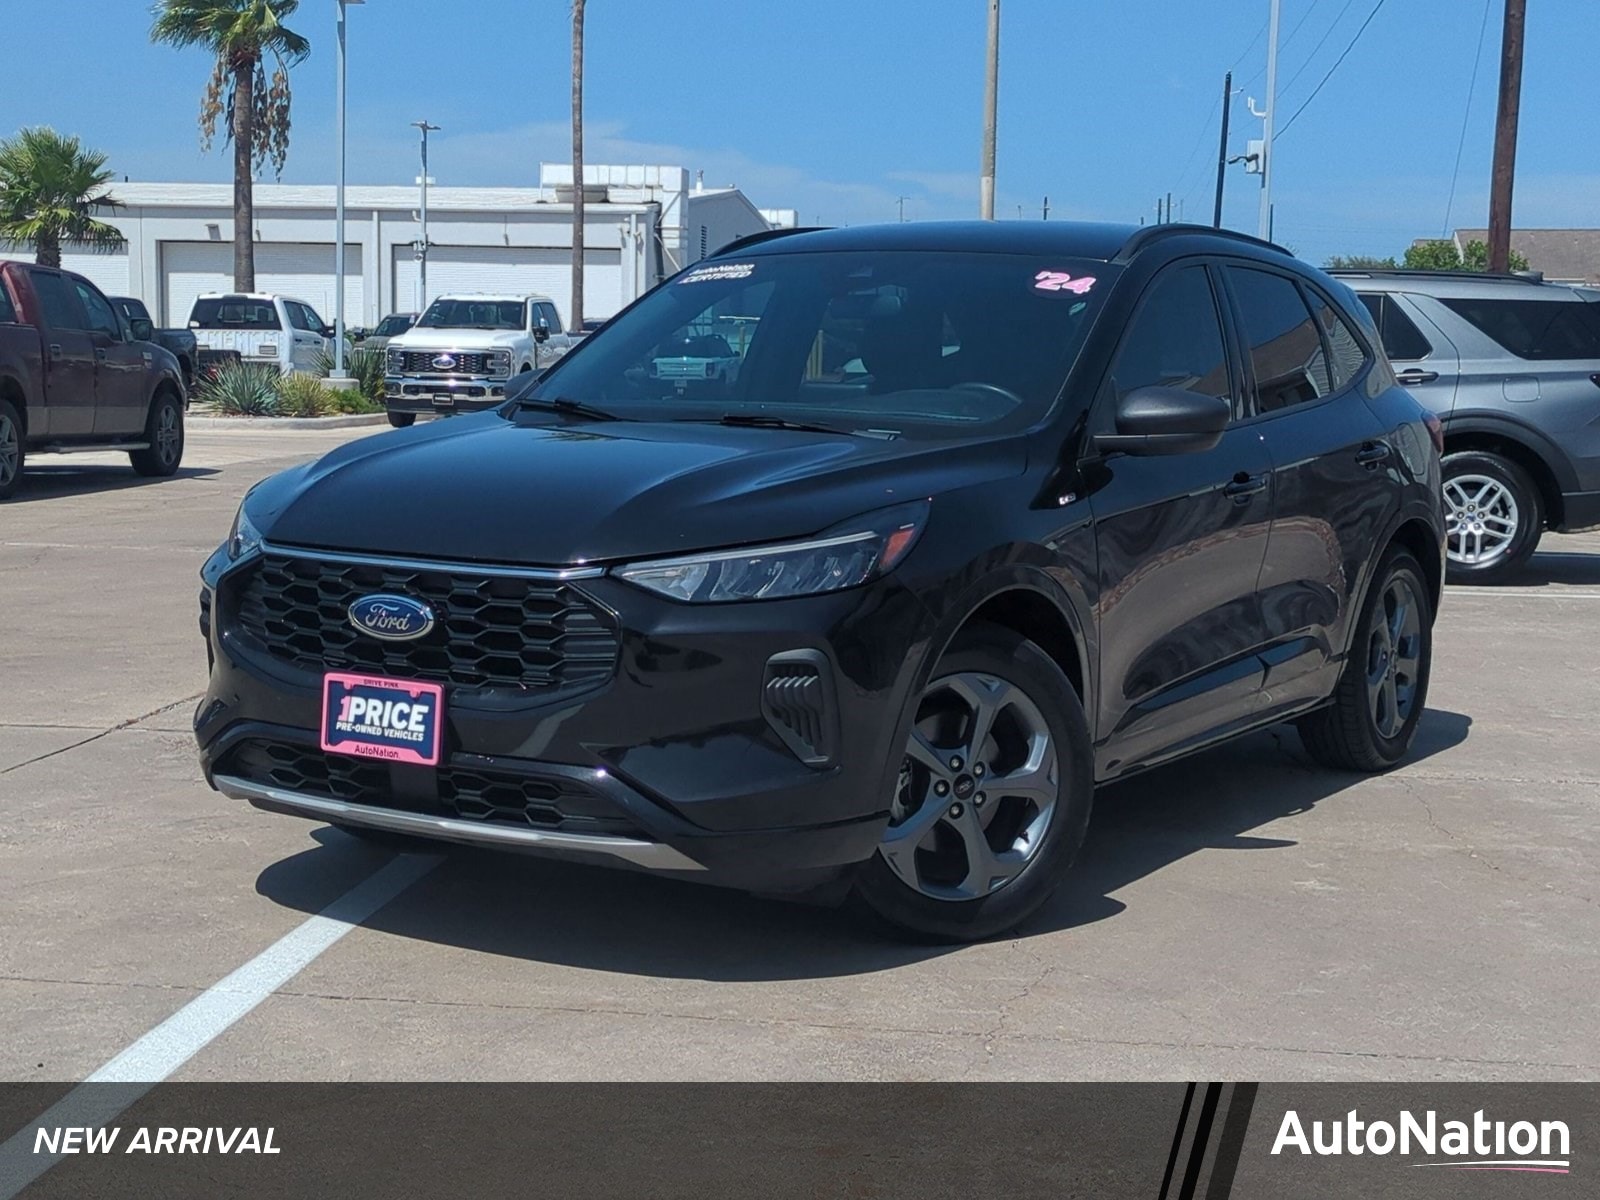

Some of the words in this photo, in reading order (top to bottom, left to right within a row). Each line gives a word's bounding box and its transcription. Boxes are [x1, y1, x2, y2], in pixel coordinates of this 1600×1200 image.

[365, 603, 411, 631] Ford
[363, 679, 383, 687] DRIVE
[384, 681, 400, 689] PINK
[336, 721, 383, 736] PRE-OWNED
[383, 727, 425, 742] VEHICLES
[354, 745, 400, 759] AutoNation
